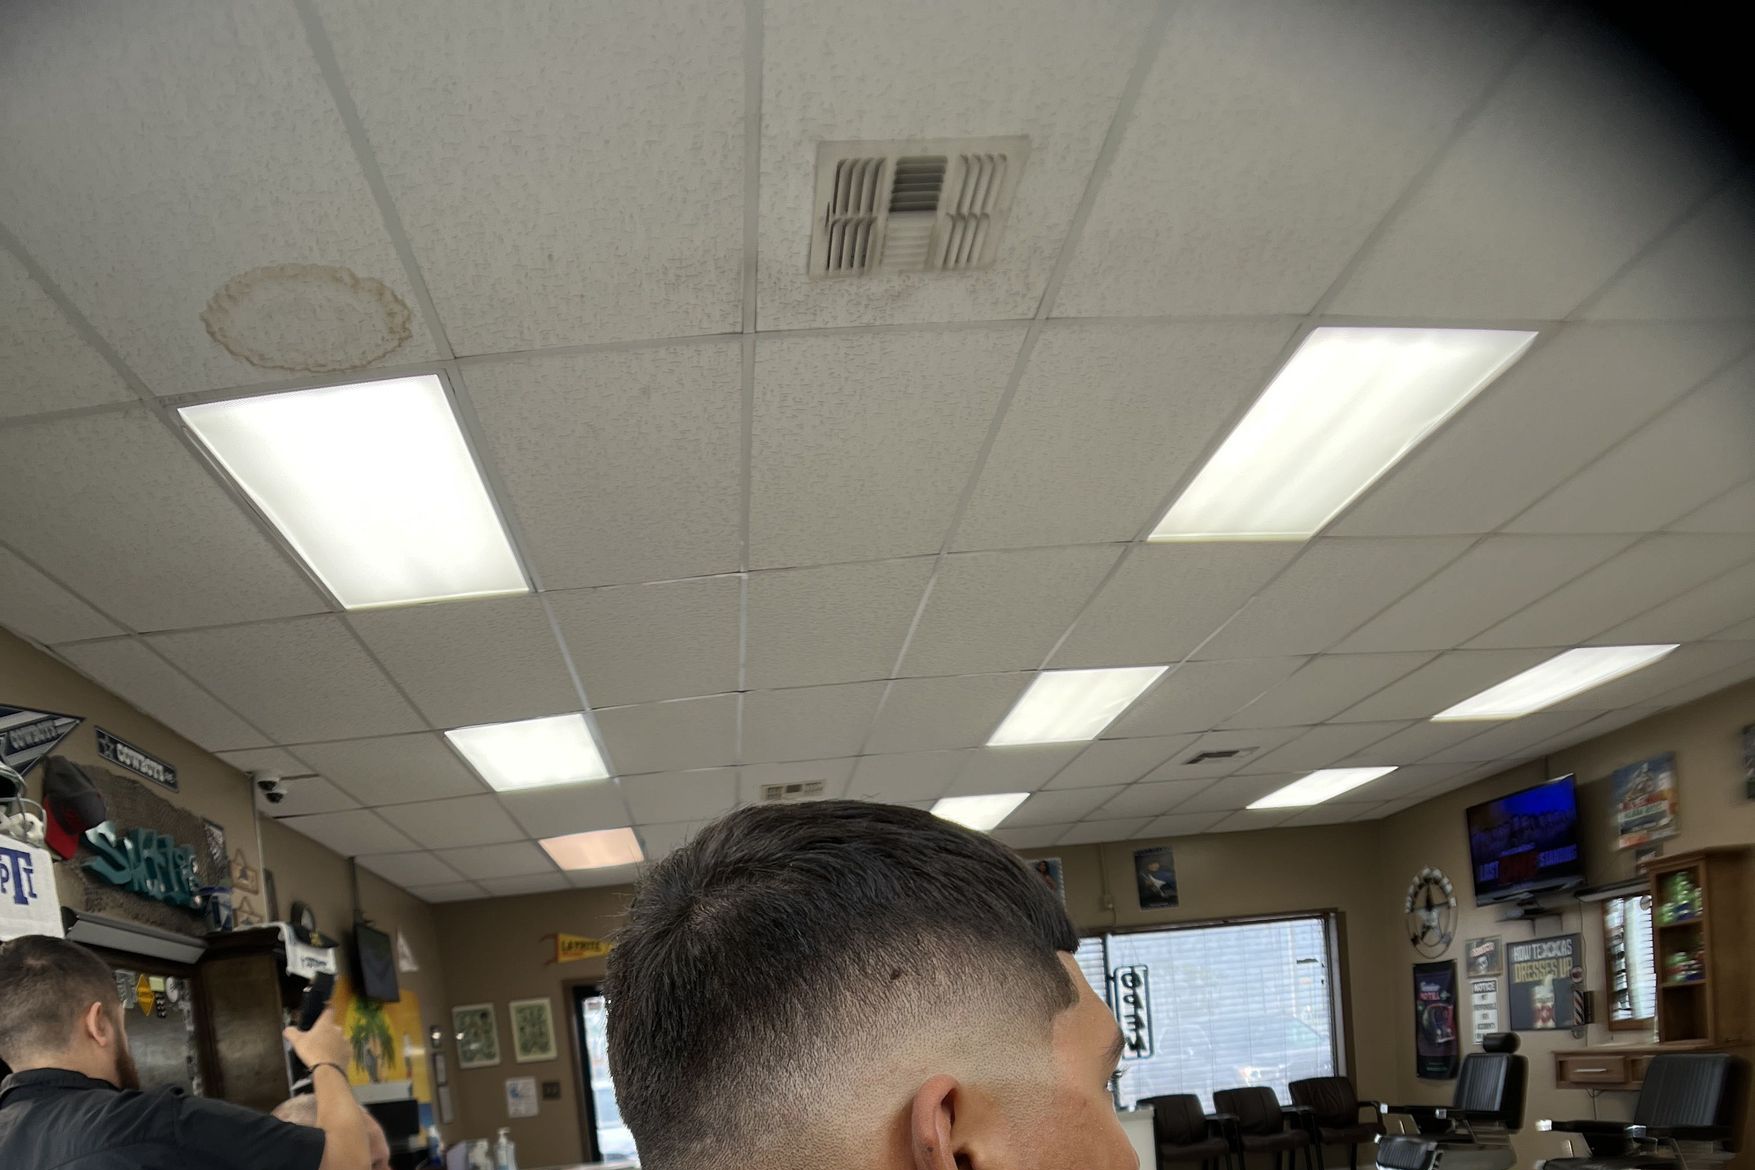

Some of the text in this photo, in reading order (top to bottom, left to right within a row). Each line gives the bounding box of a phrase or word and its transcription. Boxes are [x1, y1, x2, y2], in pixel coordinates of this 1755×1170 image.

[116, 743, 165, 782] COWBOYS
[1513, 945, 1531, 961] HOW
[1514, 959, 1558, 983] DRESSES
[1473, 982, 1496, 993] NOTICE
